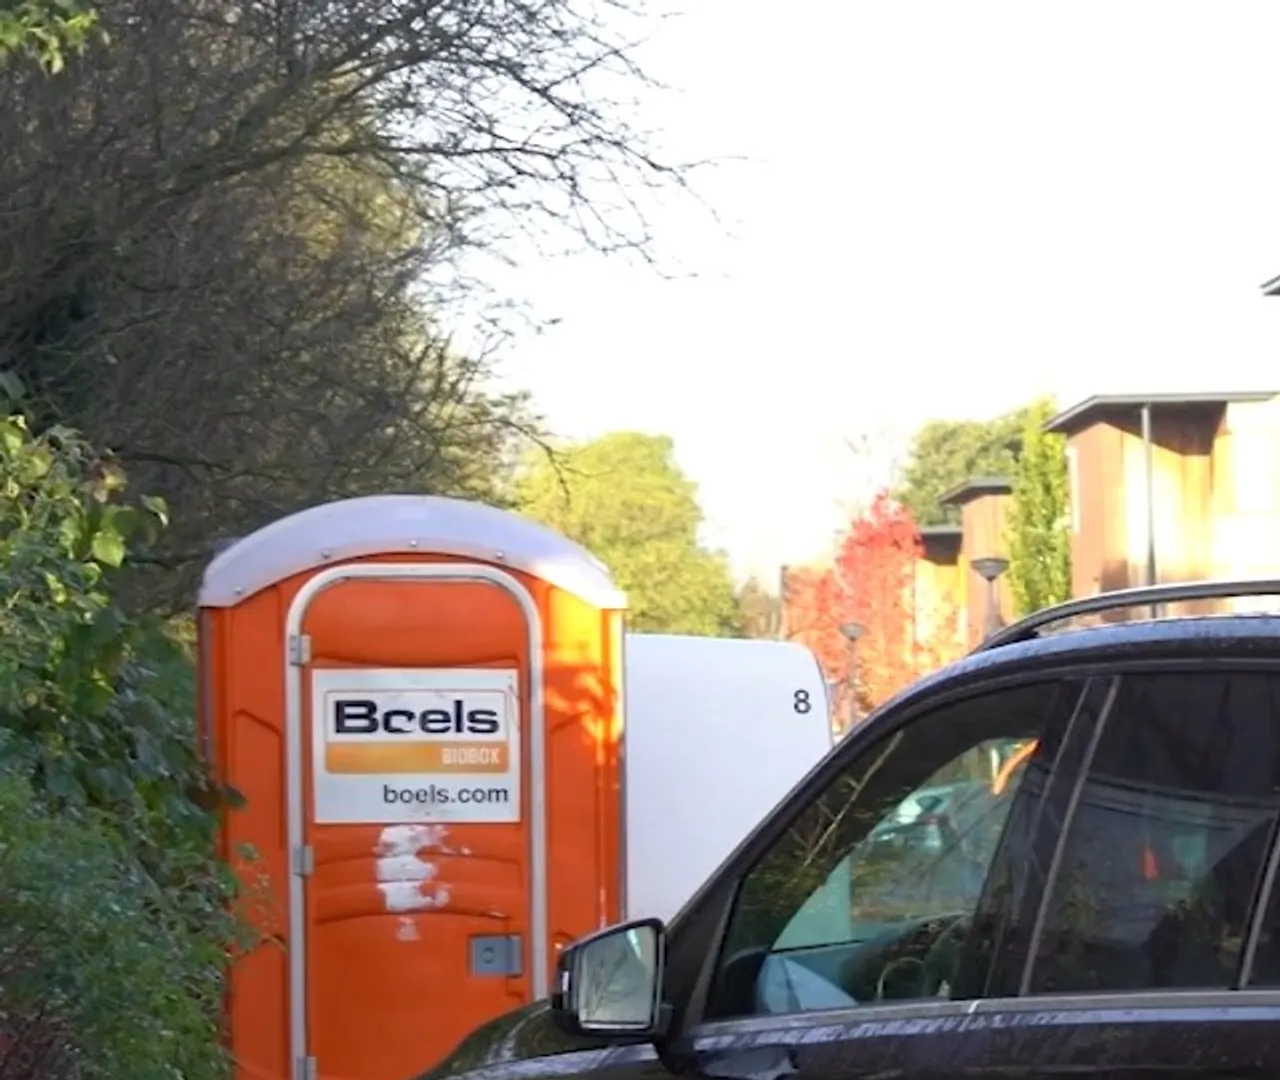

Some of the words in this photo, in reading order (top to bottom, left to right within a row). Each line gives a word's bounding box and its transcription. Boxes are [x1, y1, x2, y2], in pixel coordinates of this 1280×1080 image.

[794, 689, 812, 715] 8
[334, 699, 500, 734] Boels
[383, 784, 509, 804] boels.com
